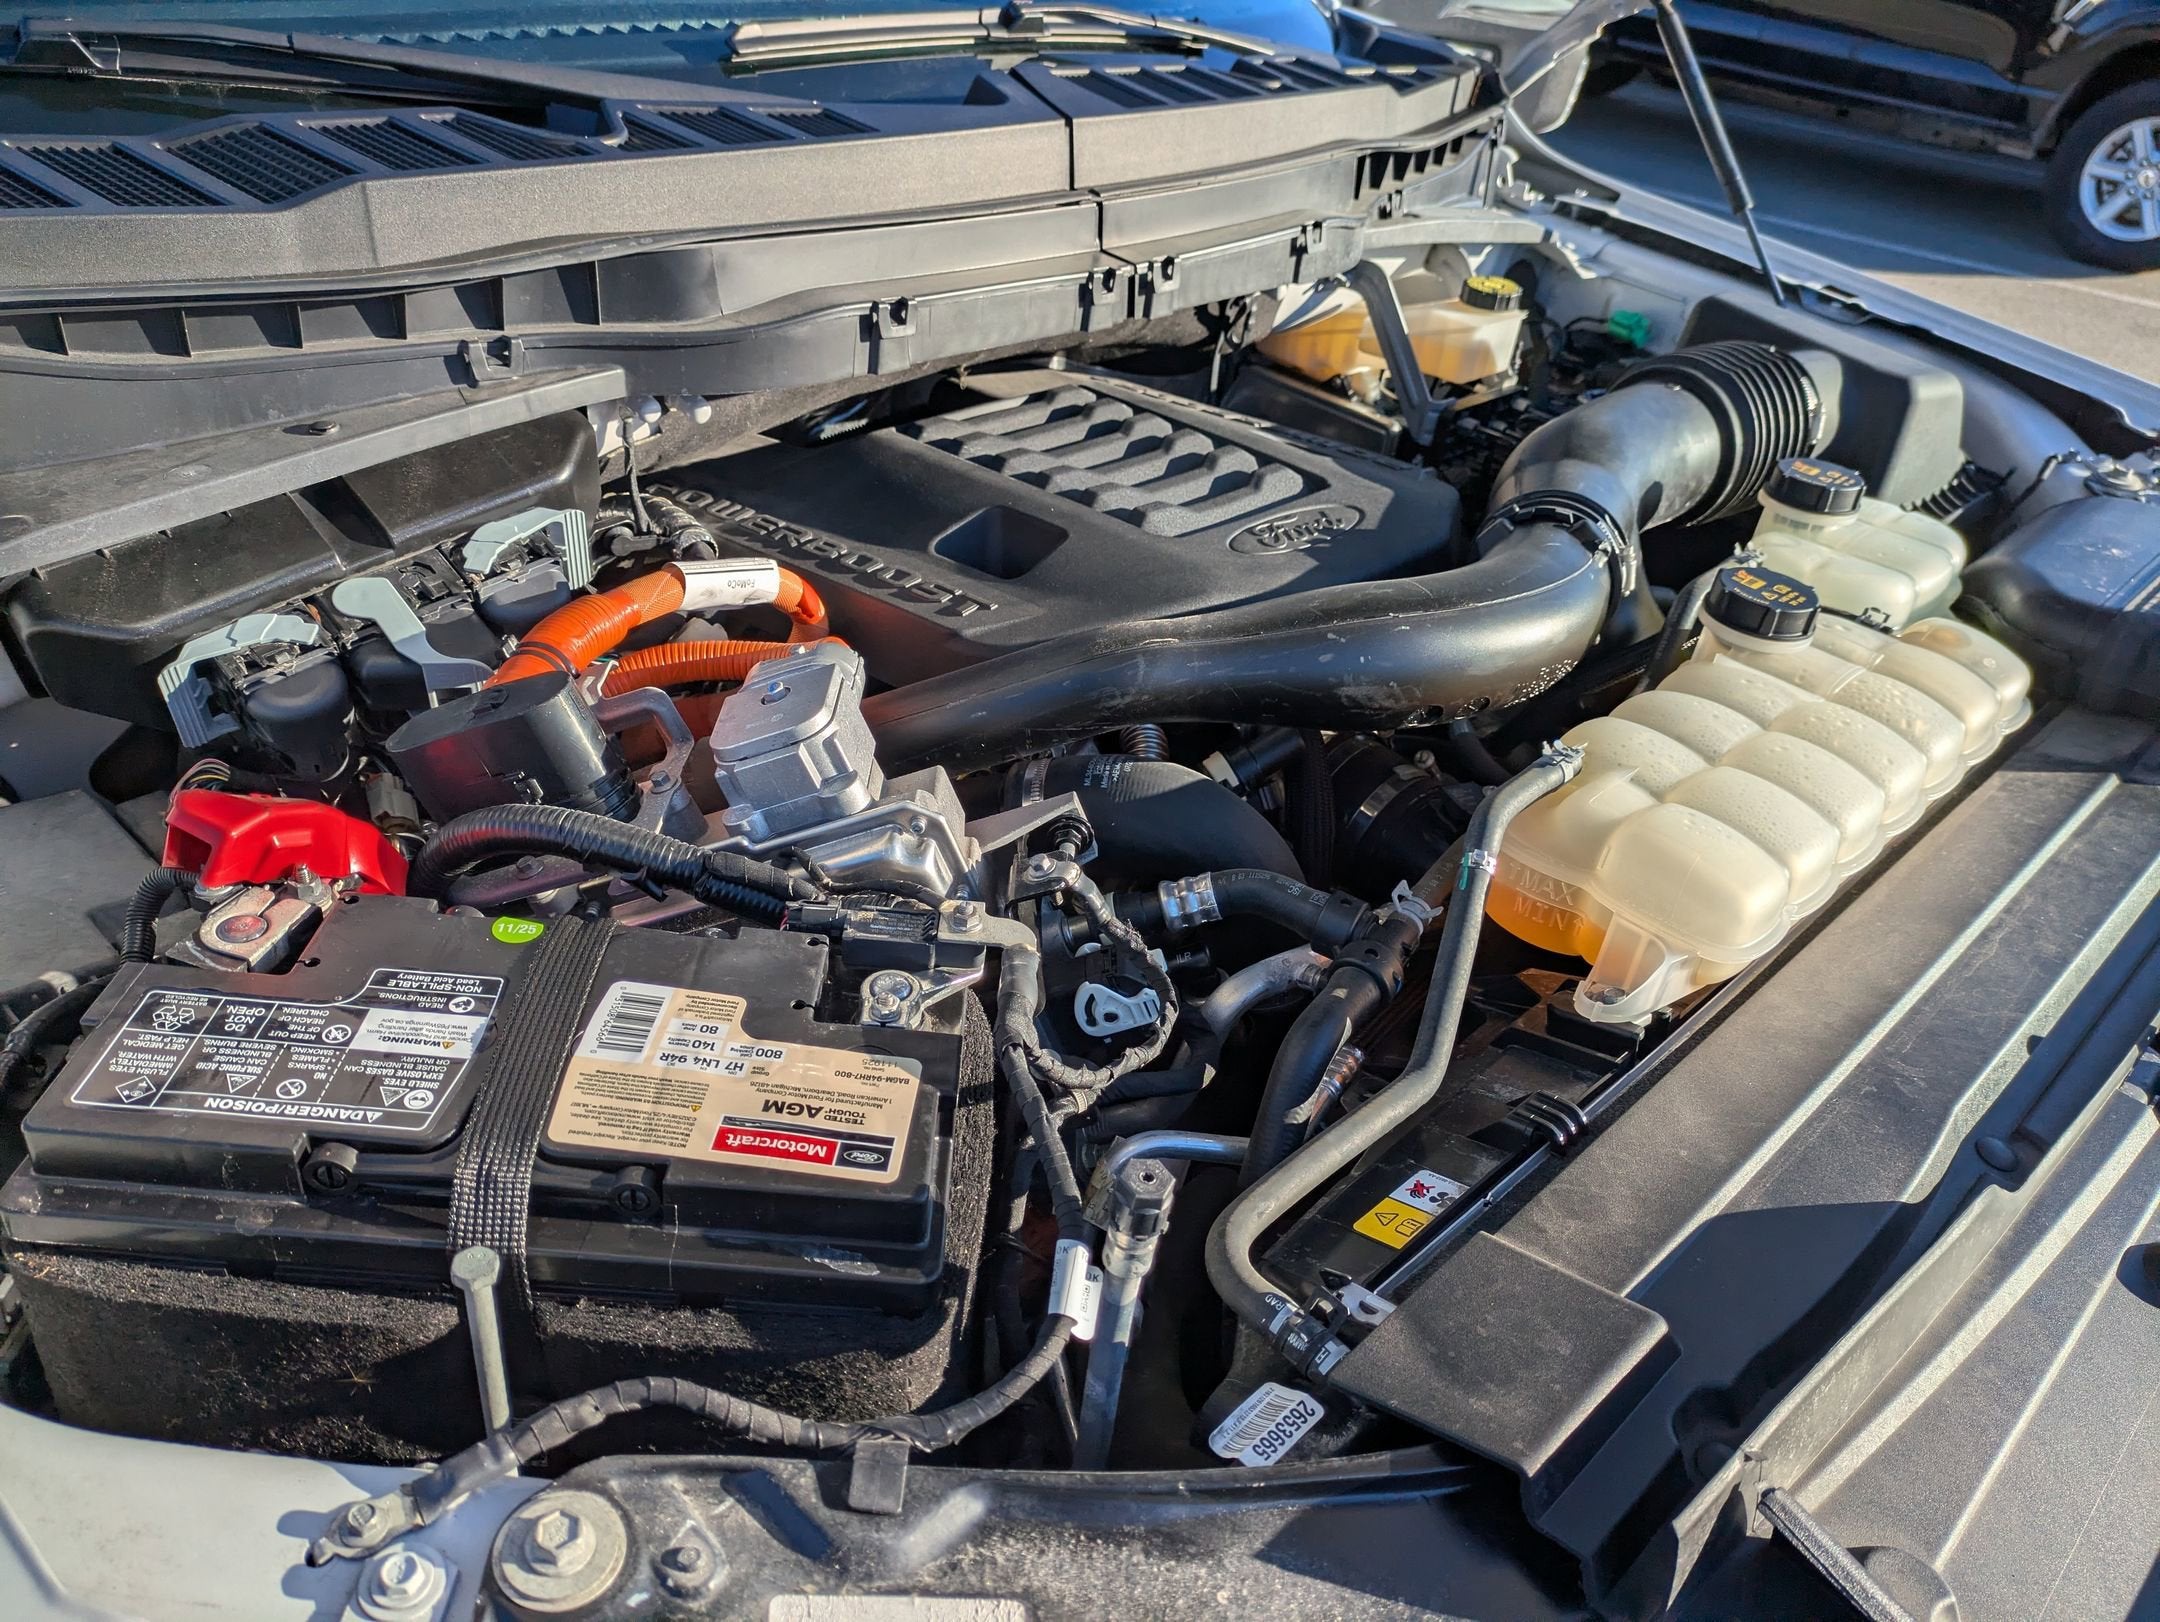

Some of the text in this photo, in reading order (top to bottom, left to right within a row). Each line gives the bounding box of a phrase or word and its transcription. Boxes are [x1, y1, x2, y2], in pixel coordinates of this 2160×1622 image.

[1246, 511, 1345, 548] Ford
[644, 483, 998, 617] POWERBOOST
[728, 579, 755, 589] FoMoCo
[1519, 869, 1577, 906] MAX
[1513, 896, 1571, 931] MIN
[498, 923, 537, 934] 11/25
[397, 973, 433, 982] Battery
[456, 978, 480, 986] Lead
[387, 979, 482, 993] NON-SPILLABLE
[378, 992, 447, 1003] INSTRUCTIONS.
[226, 1005, 266, 1016] OPEN.
[698, 1001, 737, 1009] Recommended
[282, 1007, 330, 1016] CHILDREN.
[224, 1015, 256, 1024] NOT
[292, 1016, 325, 1025] REACH
[224, 1023, 246, 1032] DO
[287, 1024, 305, 1032] THE
[596, 1020, 611, 1042] 64566
[700, 1024, 719, 1034] 80
[164, 1036, 190, 1044] HELP
[268, 1030, 316, 1040] KEEP OUT
[387, 1031, 433, 1040] Reproductive
[122, 1039, 185, 1051] GET MEDICAL
[203, 1038, 277, 1051] SEVERE BURNS.
[378, 1036, 441, 1048] WARNING:
[692, 1040, 716, 1051] 140
[118, 1050, 177, 1062] WITH WATER.
[218, 1048, 272, 1058] BLINDNESS
[290, 1046, 334, 1056] SMOKING
[755, 1048, 783, 1059] 800
[110, 1057, 174, 1068] IMMEDIATELY
[213, 1055, 268, 1066] CAN CAUSE
[292, 1054, 330, 1063] FLAMES
[400, 1055, 450, 1066] OR INJURY.
[659, 1053, 688, 1063] 94R
[693, 1056, 720, 1069] LN4
[196, 1062, 263, 1073] SULFURIC ACID
[288, 1062, 326, 1070] SPARKS
[360, 1059, 447, 1072] CAUSE BLINDNESS
[725, 1061, 744, 1072] H7
[136, 1067, 169, 1076] FLUSH
[313, 1072, 327, 1080] NO
[344, 1065, 444, 1080] EXPLOSIVE GASES CAN
[834, 1070, 910, 1085] BAGM-94RH7-800
[382, 1078, 439, 1089] SHIELD EYES.
[771, 1083, 801, 1092] Michigan
[755, 1087, 787, 1096] Company
[802, 1088, 836, 1096] Dearborn,
[835, 1098, 883, 1109] Manufactured
[856, 1095, 889, 1103] American
[204, 1097, 364, 1120] DANGER/POISON
[651, 1101, 690, 1109] PROPOSITION
[762, 1099, 824, 1119] AGM
[626, 1119, 653, 1127] warranty
[661, 1119, 695, 1127] distributor
[824, 1114, 864, 1125] TESTED
[654, 1122, 682, 1130] complete
[663, 1129, 690, 1137] Warranty
[726, 1134, 828, 1158] Motorcraft
[848, 1151, 878, 1162] Ford
[1265, 1294, 1285, 1311] RAD
[1252, 1400, 1316, 1461] 2653665
